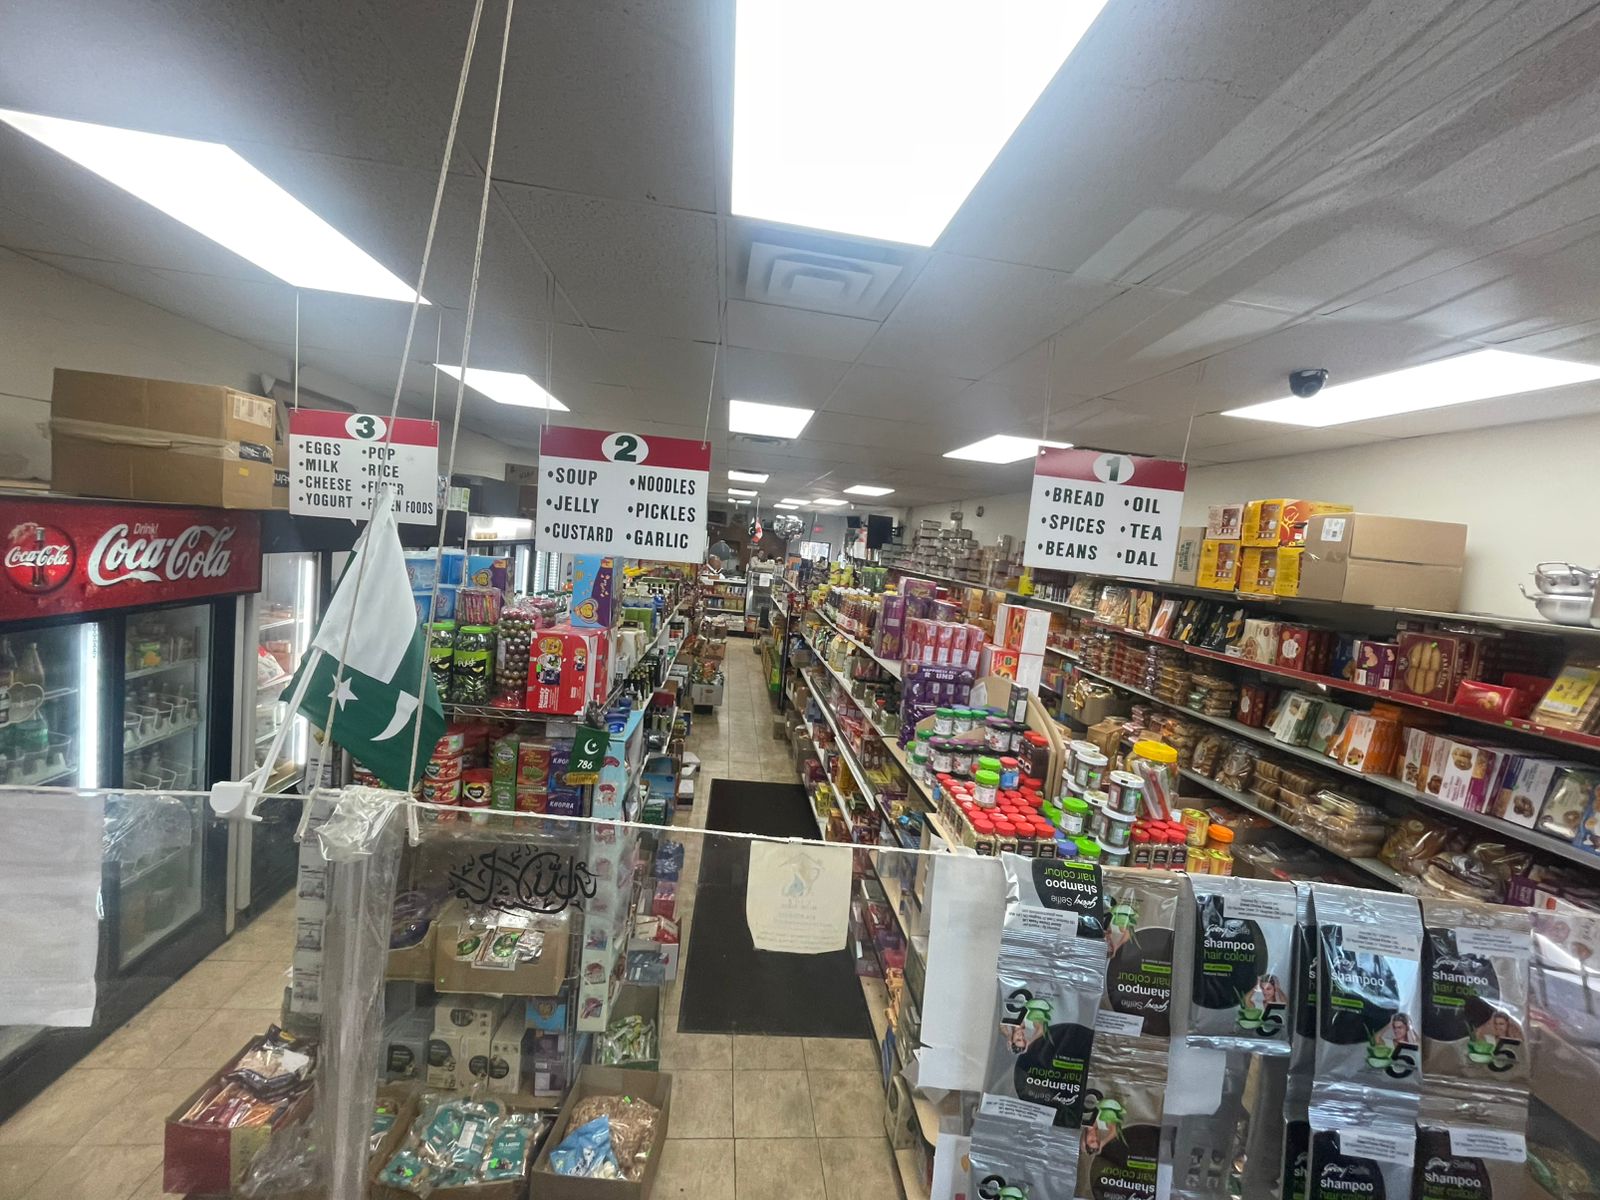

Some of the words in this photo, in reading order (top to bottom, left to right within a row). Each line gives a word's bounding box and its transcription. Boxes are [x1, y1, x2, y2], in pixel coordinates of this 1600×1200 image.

[355, 416, 375, 439] 3
[306, 441, 341, 456] EGGS
[368, 446, 396, 461] POP
[614, 435, 638, 462] 2
[306, 458, 339, 473] MILK
[368, 464, 399, 478] RICE
[1106, 456, 1121, 482] 1
[306, 475, 352, 491] CHEESE
[556, 467, 598, 486] SOUP
[638, 475, 696, 496] NOODLES
[306, 493, 352, 508] YOGURT
[554, 495, 600, 514] JELLY
[1052, 487, 1105, 507] BREAD
[1132, 496, 1161, 514] OIL
[406, 500, 433, 515] FOODS
[636, 502, 696, 523] PICKLES
[552, 522, 614, 543] CUSTARD
[1049, 514, 1106, 535] SPICES
[1130, 523, 1163, 541] TEA
[634, 529, 689, 549] GARLIC
[5, 545, 70, 568] Coca-Cola
[88, 524, 236, 587] Coca-Cola
[1045, 541, 1098, 560] BEANS
[1125, 549, 1159, 567] DAL
[577, 760, 593, 770] 786
[1044, 867, 1076, 880] colour
[1079, 870, 1096, 884] hair
[1045, 879, 1098, 895] shampoo
[1050, 894, 1072, 906] Selfie
[1204, 938, 1255, 952] shampoo
[1224, 951, 1256, 962] colour
[1117, 972, 1150, 984] colour
[1331, 970, 1385, 987] shampoo
[1432, 970, 1489, 986] shampoo
[1117, 984, 1171, 1000] shampoo
[1256, 1004, 1287, 1037] 5
[1385, 1042, 1419, 1079] 5
[1488, 1038, 1521, 1073] 5
[1026, 1077, 1081, 1094] shampoo
[1100, 1176, 1156, 1194] shampoo
[1320, 1177, 1374, 1192] shampoo
[1424, 1172, 1482, 1188] shampoo
